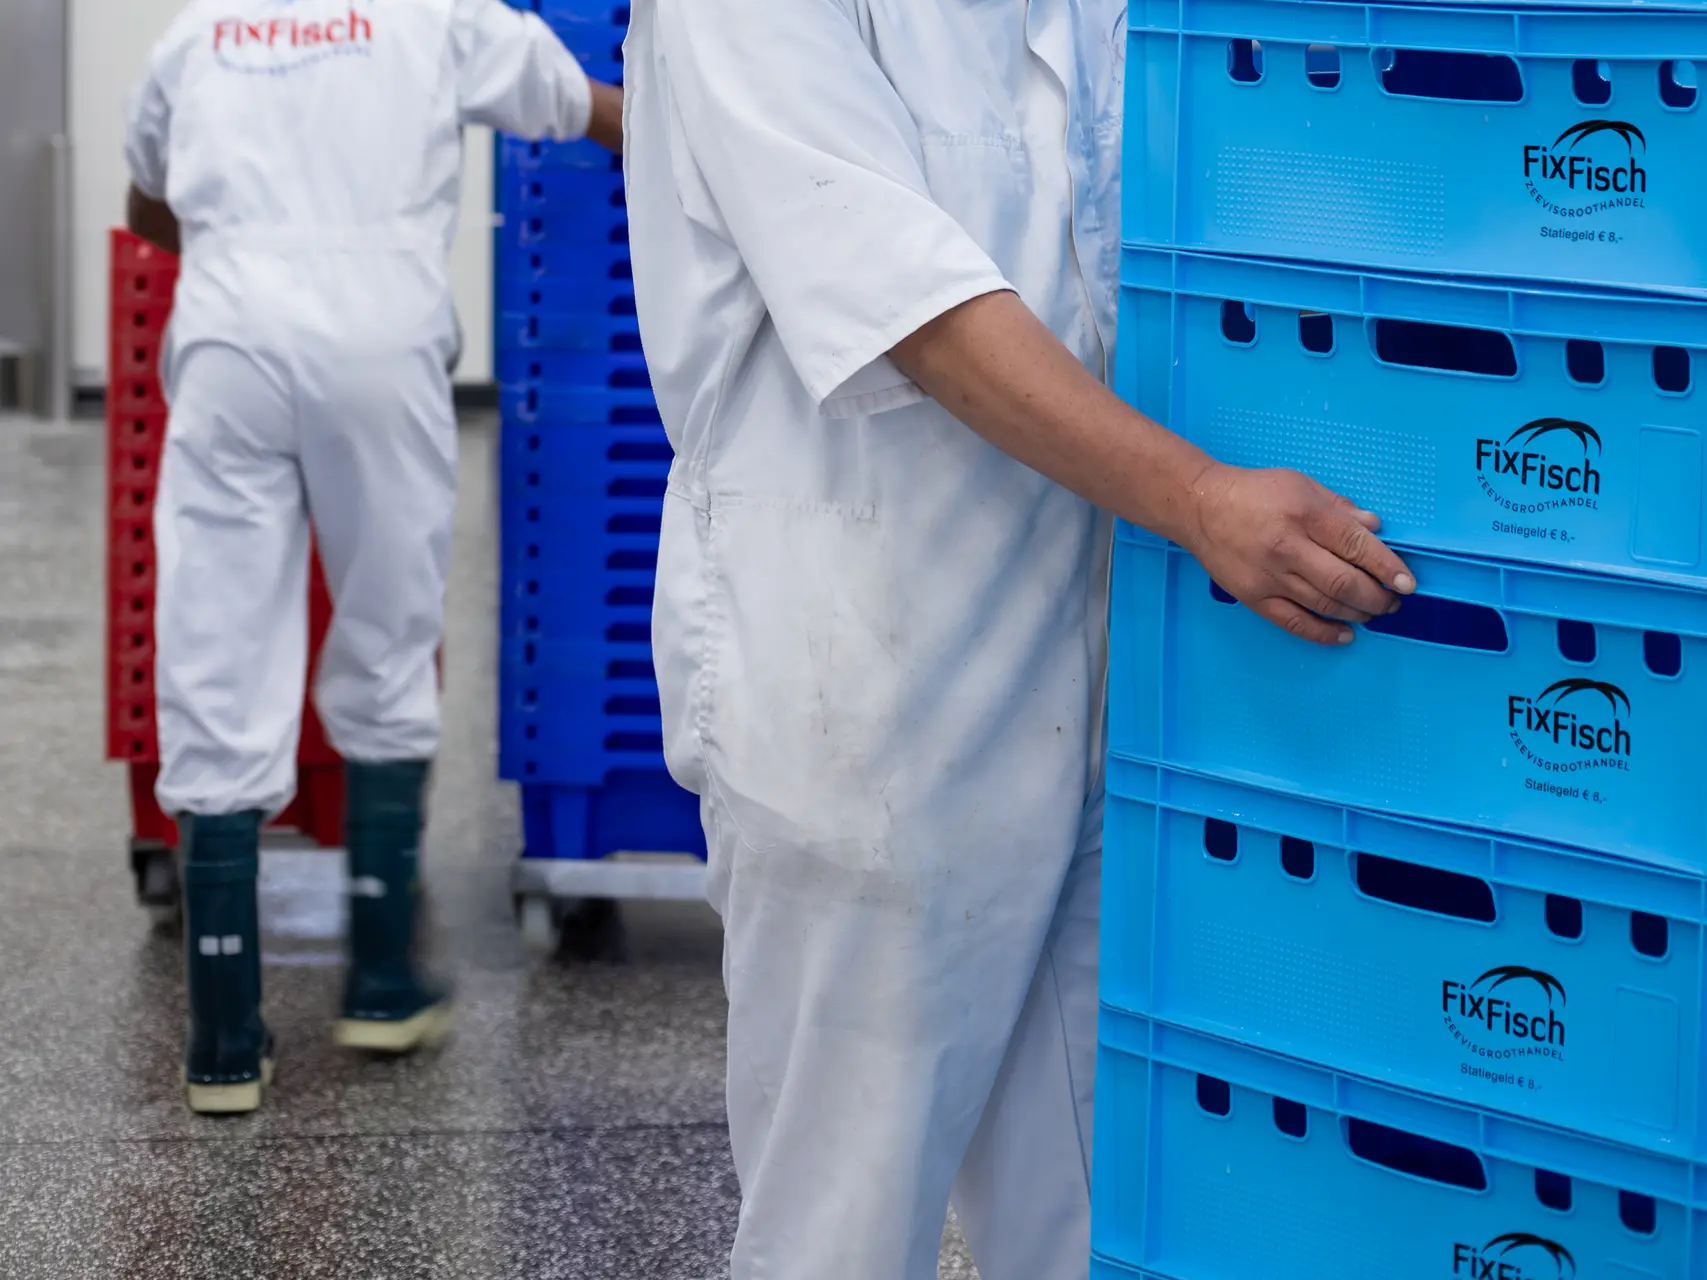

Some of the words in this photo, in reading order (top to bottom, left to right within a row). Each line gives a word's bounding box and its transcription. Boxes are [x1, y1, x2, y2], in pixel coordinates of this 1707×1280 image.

[213, 9, 372, 53] FixFisch
[1523, 145, 1646, 193] FixFisch
[1525, 180, 1645, 218] ZEEVISGROOTHANDEL
[1540, 226, 1595, 242] Statiegeld
[1476, 438, 1600, 495] FixFisch
[1476, 473, 1599, 513] ZEEVISGROOTHANDEL
[1492, 520, 1547, 538] Statiegeld
[1508, 695, 1631, 756] FixFisch
[1510, 730, 1630, 773] ZEEVISGROOTHANDEL
[1525, 778, 1579, 798] Statiegeld
[1442, 980, 1565, 1047] FixFisch
[1443, 1016, 1564, 1062] ZEEVISGROOTHANDEL
[1460, 1063, 1514, 1085] Statiegeld
